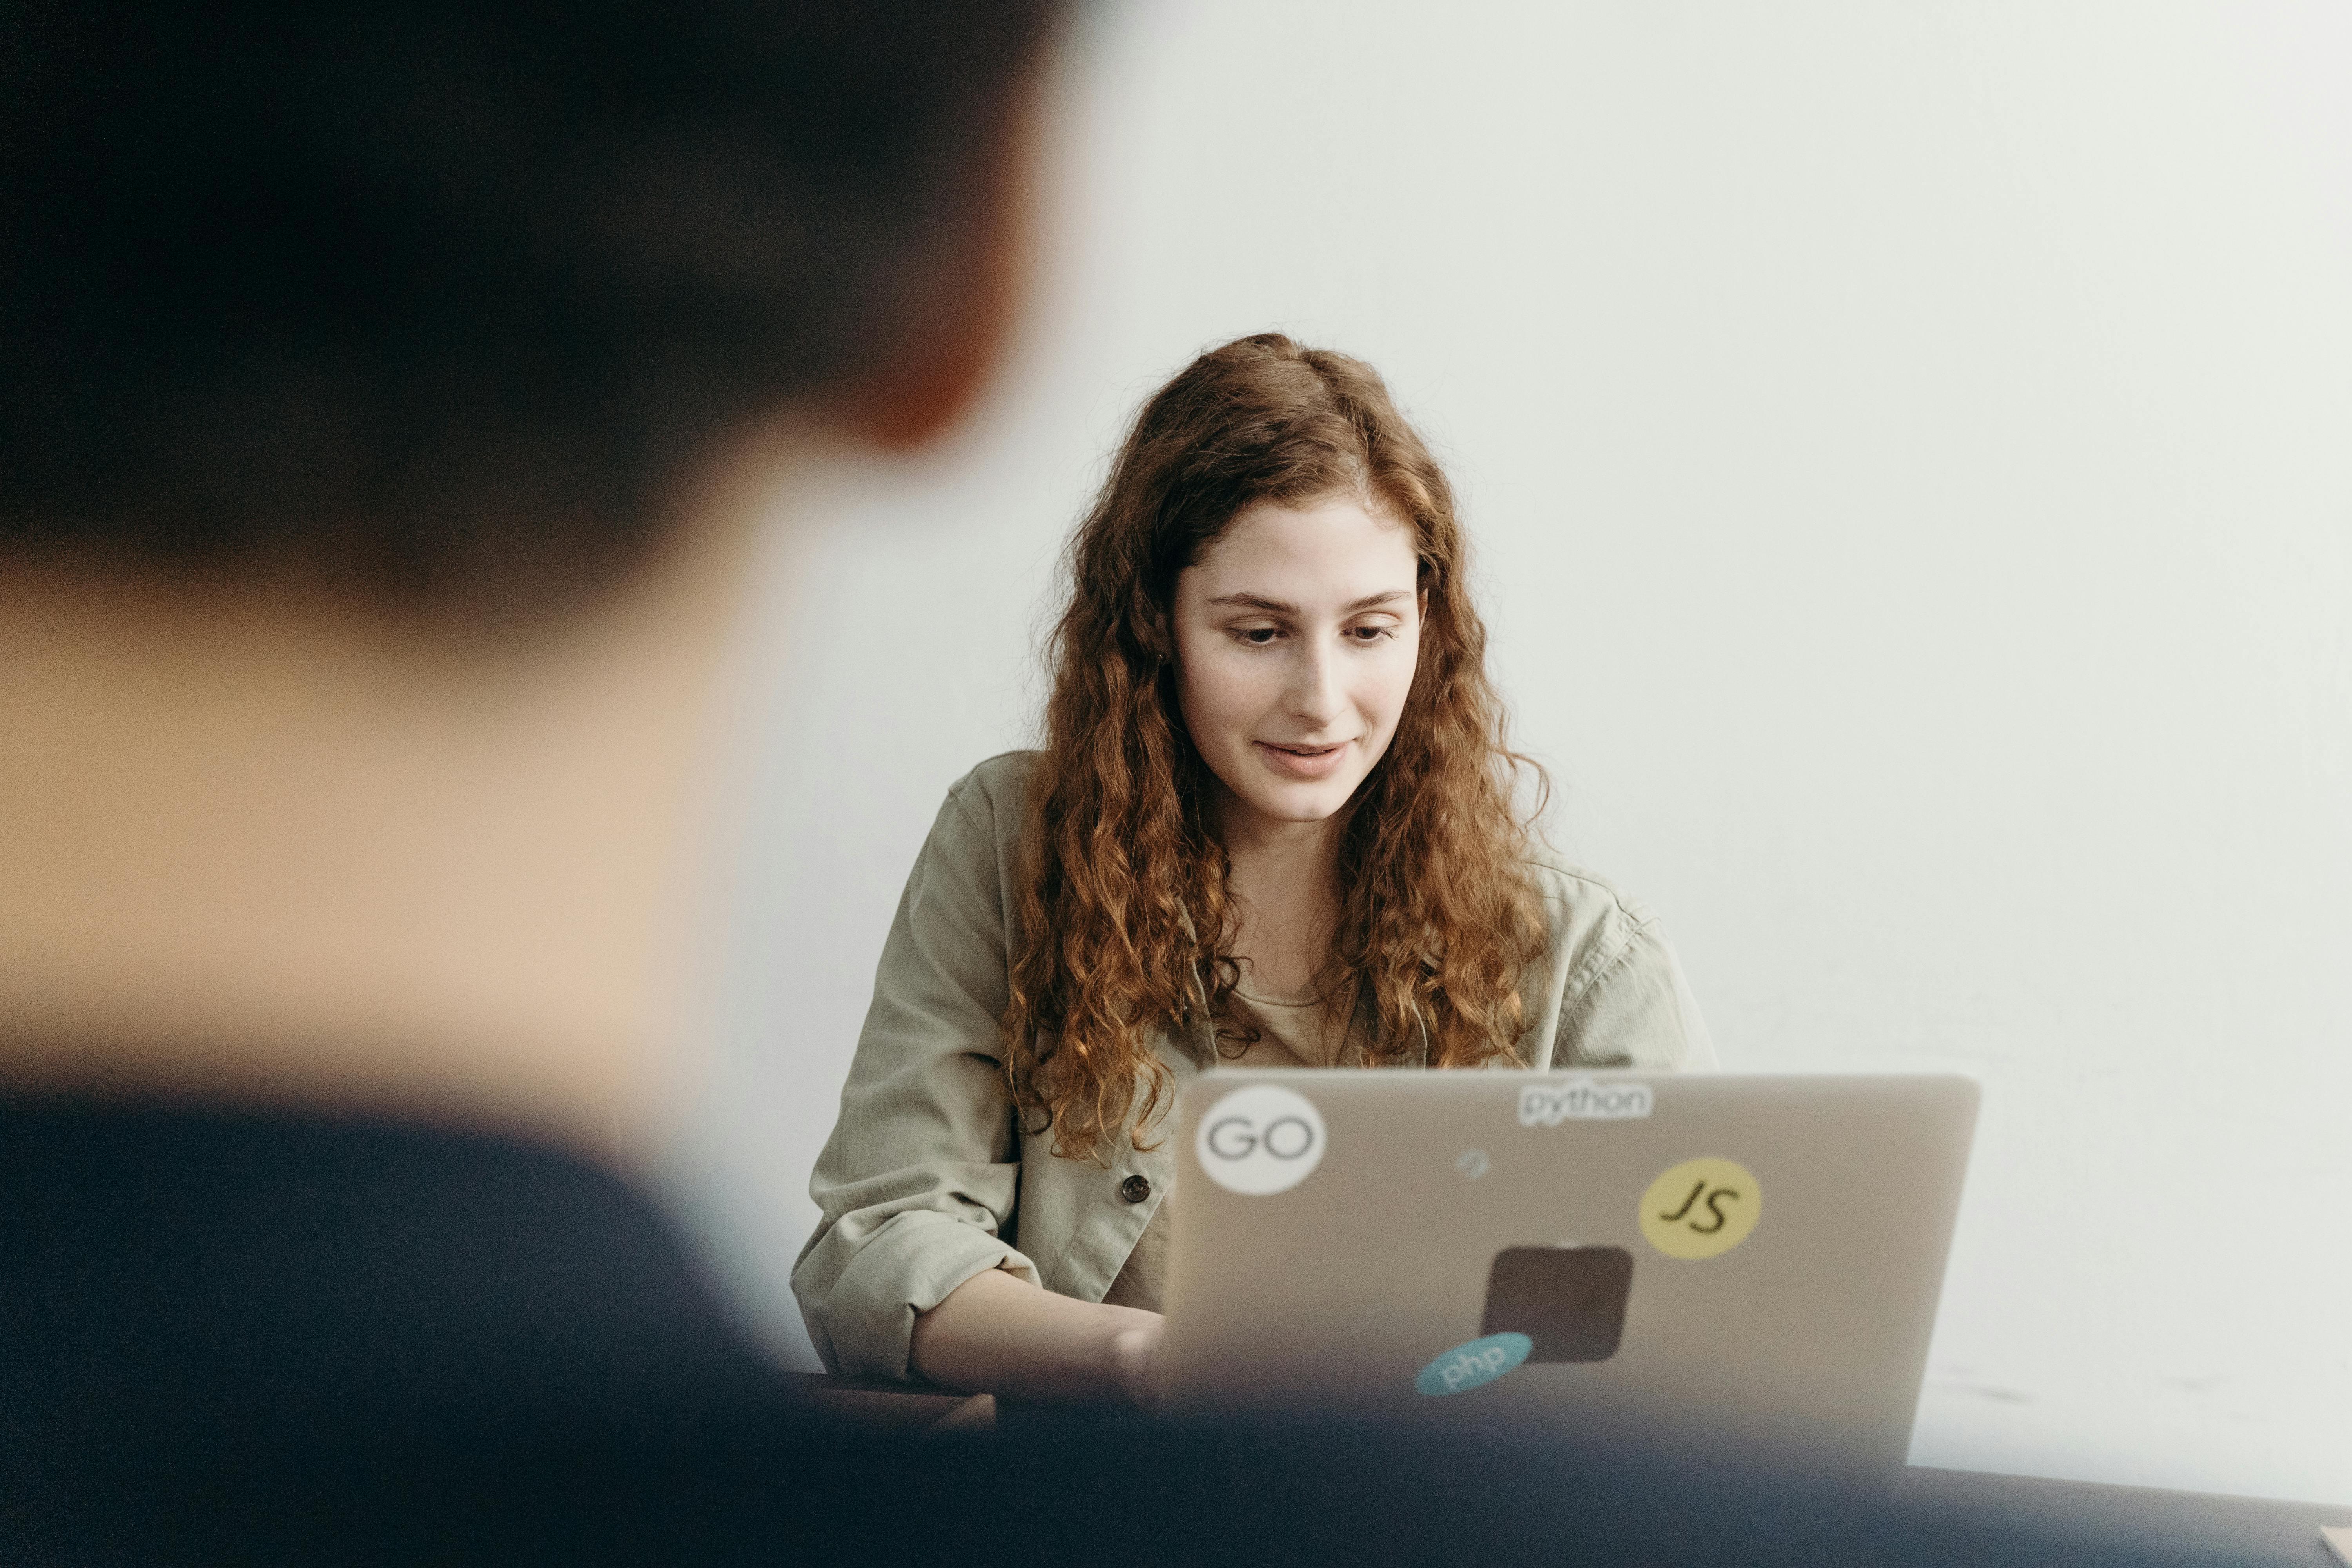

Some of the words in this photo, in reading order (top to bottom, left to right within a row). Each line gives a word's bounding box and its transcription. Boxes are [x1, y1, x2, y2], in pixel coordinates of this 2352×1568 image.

[1523, 1084, 1646, 1119] python
[1208, 1115, 1314, 1161] GO
[1659, 1180, 1740, 1235] JS
[1443, 1347, 1504, 1392] php
